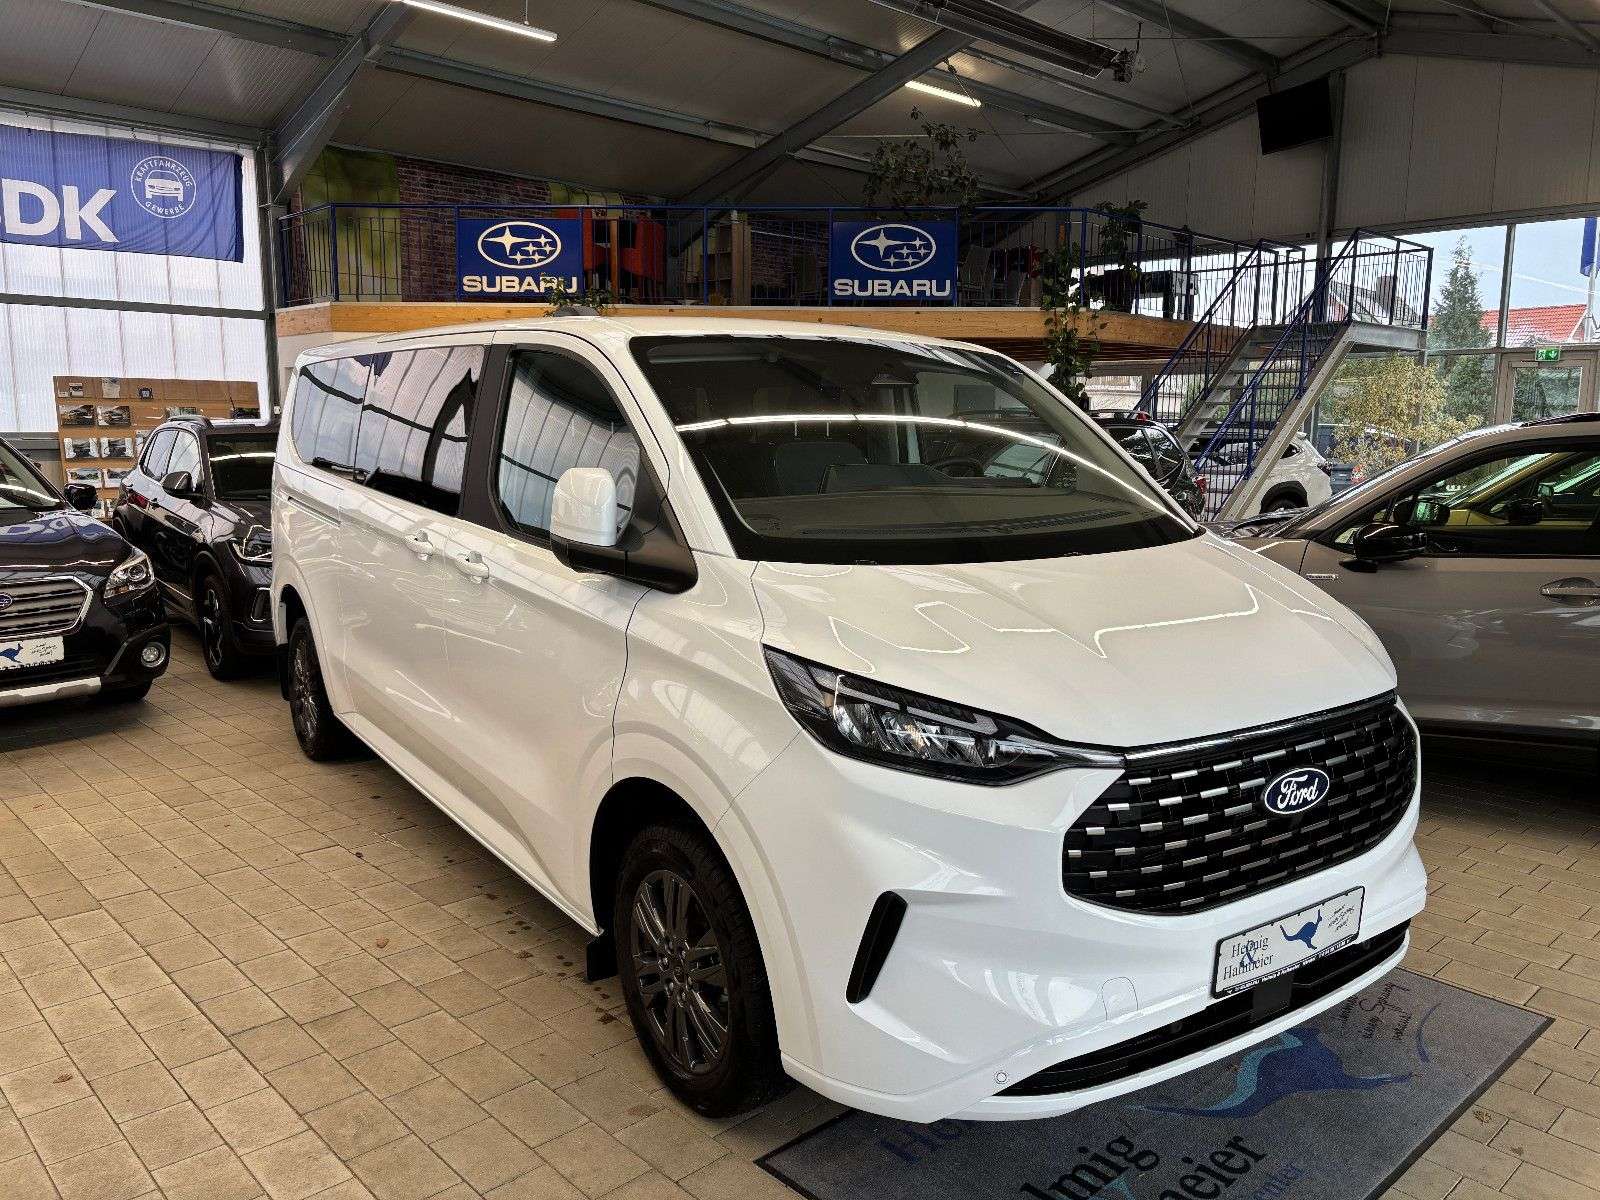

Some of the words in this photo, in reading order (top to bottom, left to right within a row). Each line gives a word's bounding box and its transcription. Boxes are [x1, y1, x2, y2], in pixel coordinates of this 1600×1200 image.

[135, 160, 193, 188] KRAFTFAHRZEUG
[0, 178, 119, 243] DK
[145, 201, 185, 215] GEWERBE
[833, 278, 951, 297] SUBARU
[1277, 774, 1319, 809] Ford
